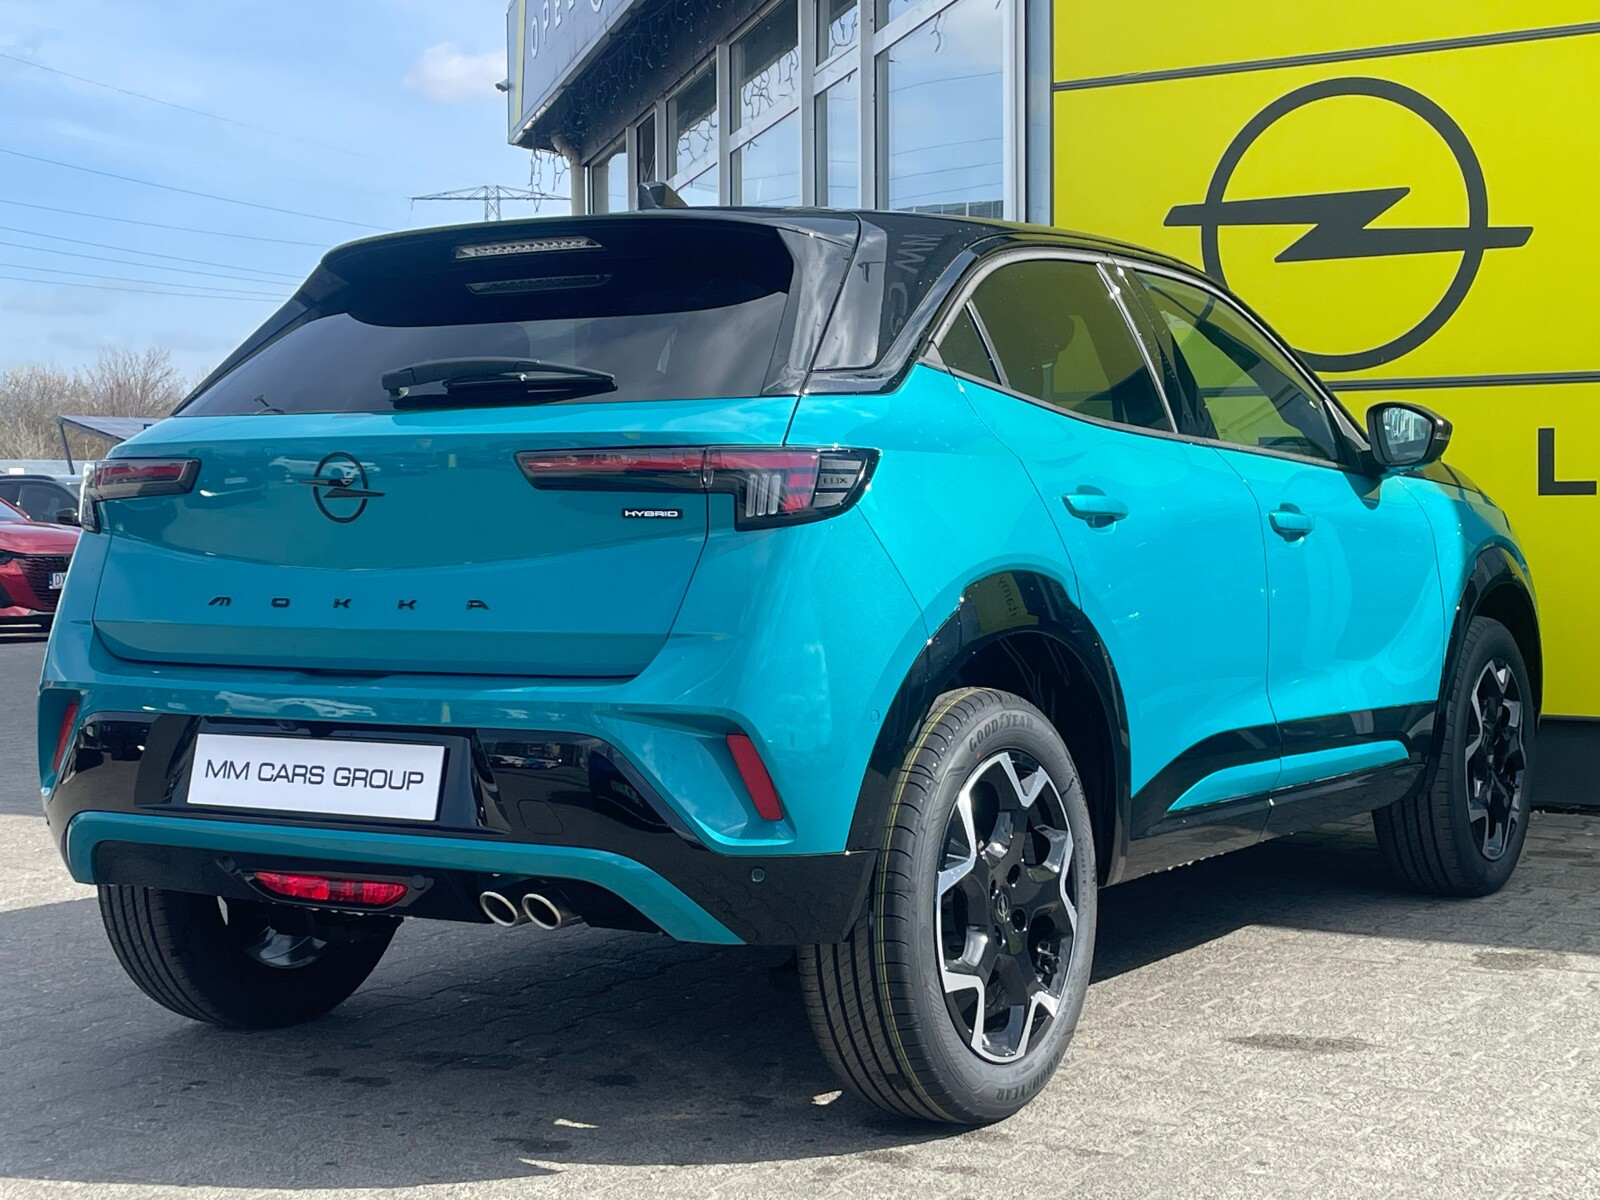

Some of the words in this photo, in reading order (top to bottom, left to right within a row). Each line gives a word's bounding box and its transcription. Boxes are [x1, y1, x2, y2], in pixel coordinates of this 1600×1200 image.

[1537, 427, 1597, 496] L
[624, 510, 679, 518] HYBRID
[208, 596, 490, 610] MOKKA
[969, 712, 1034, 753] GOODYEAR
[204, 759, 251, 781] MM
[257, 762, 326, 785] CARS
[333, 766, 425, 791] GROUP
